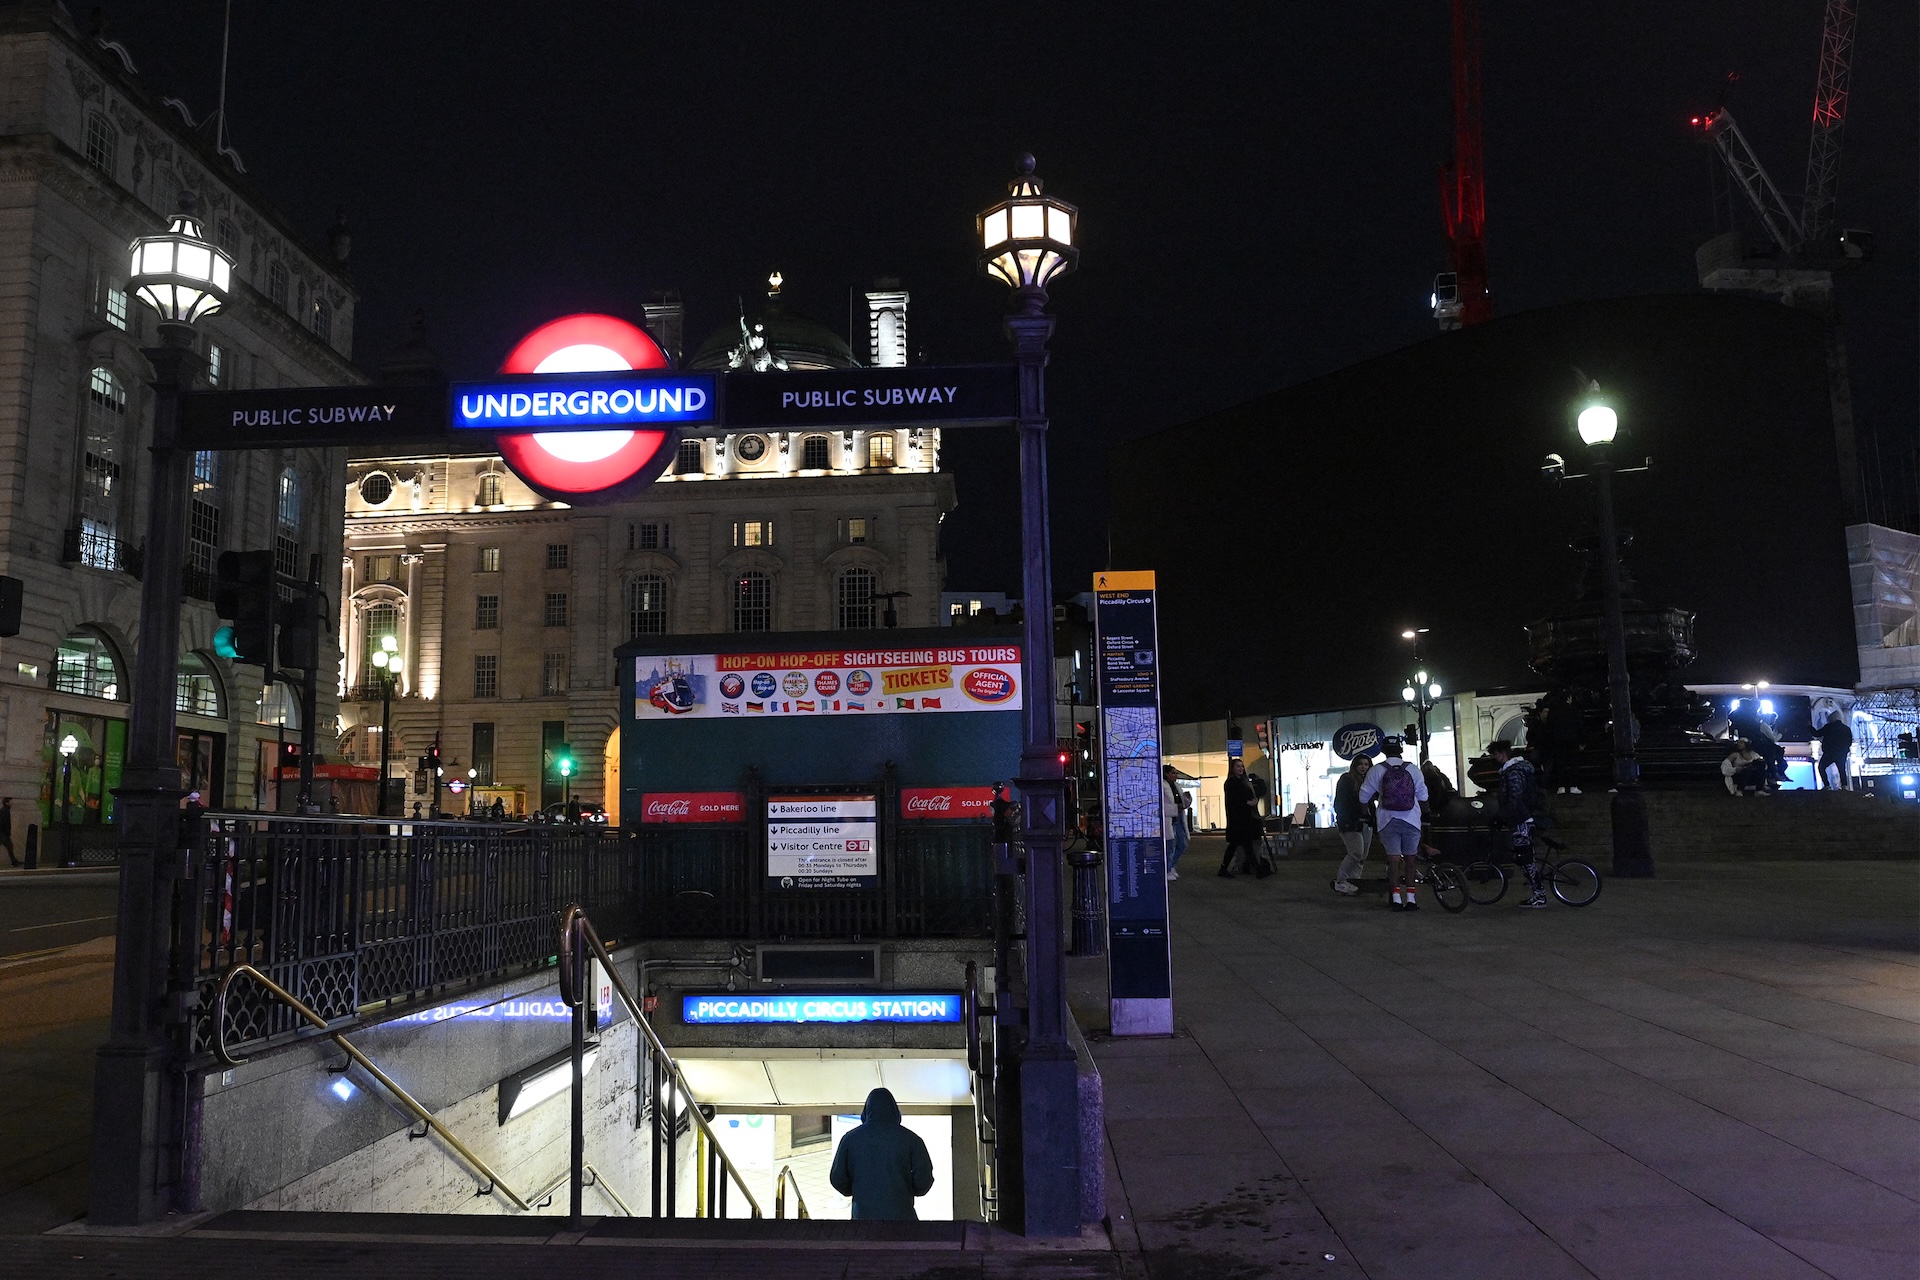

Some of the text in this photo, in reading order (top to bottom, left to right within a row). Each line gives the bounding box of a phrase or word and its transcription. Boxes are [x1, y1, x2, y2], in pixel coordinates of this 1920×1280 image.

[461, 387, 707, 419] UNDERGROUND
[782, 386, 957, 408] PUBLIC SUBWAY
[232, 404, 396, 427] PUBLIC SUBWAY
[723, 648, 1016, 669] HOP-ON HOP-OFF SIGHTSEEING BUS TOURS
[886, 668, 949, 689] TICKETS
[972, 672, 1008, 682] OFFICIAL
[976, 680, 1004, 690] AGENT
[1281, 741, 1324, 754] pharmacy
[1339, 728, 1379, 755] Boots
[648, 800, 692, 816] Coca-Cola
[780, 804, 837, 813] Bakerloo line
[907, 796, 953, 812] Coca-Cola
[780, 826, 820, 835] Piccadilly
[780, 842, 809, 850] Visitor
[812, 842, 842, 850] Centre
[601, 986, 610, 1005] LFB
[698, 1001, 946, 1018] PICCADILLY CIRCUS STATION
